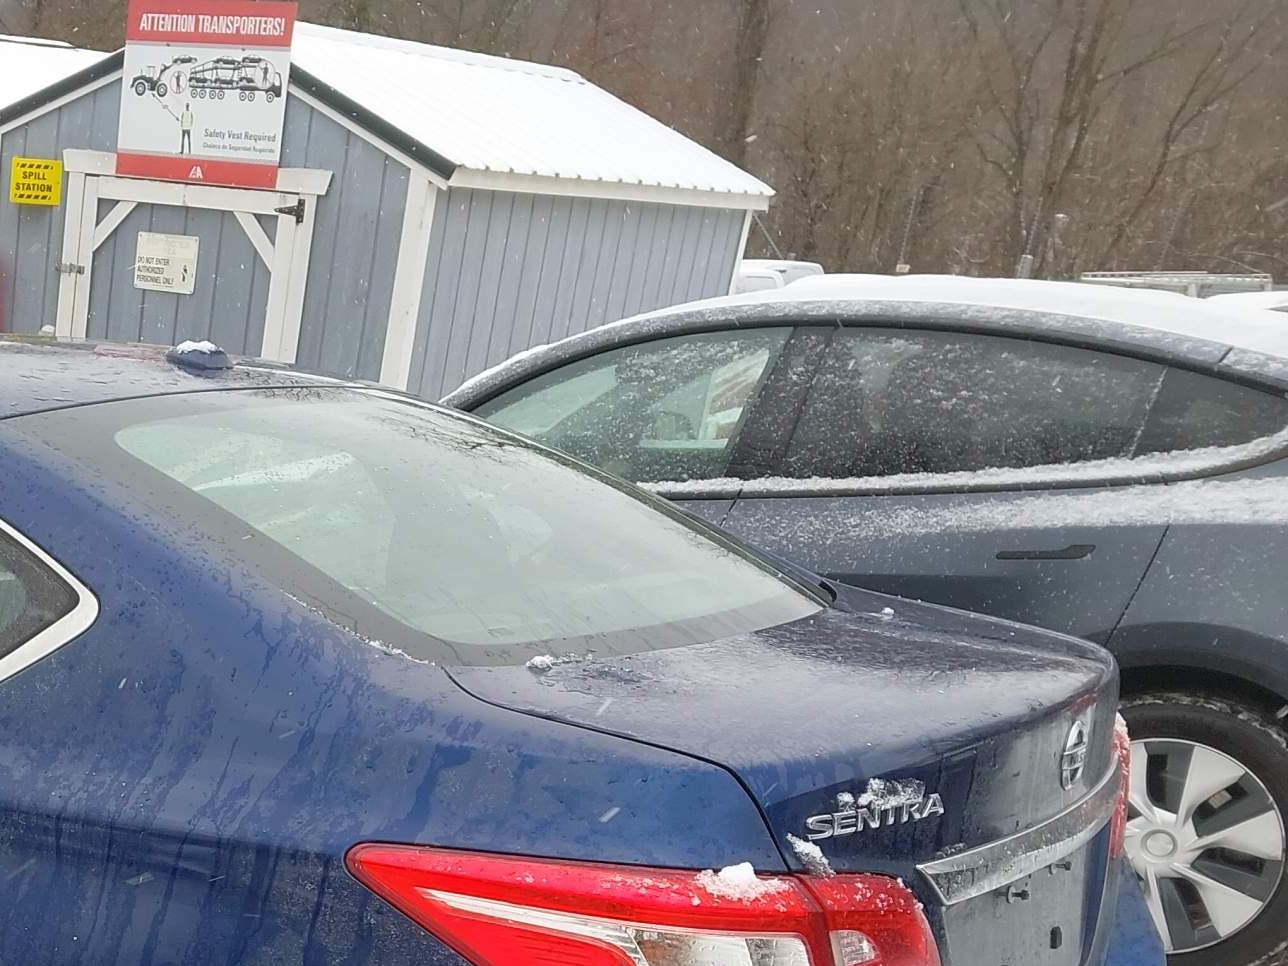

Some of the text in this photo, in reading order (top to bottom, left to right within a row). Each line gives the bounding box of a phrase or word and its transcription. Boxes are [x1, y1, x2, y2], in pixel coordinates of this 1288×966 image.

[139, 13, 285, 36] ATTENTION TRANSPORTERS!
[203, 128, 276, 143] Safety Vest Required
[22, 171, 47, 181] SPILL
[15, 182, 53, 193] STATION
[805, 793, 945, 841] SENTRA
